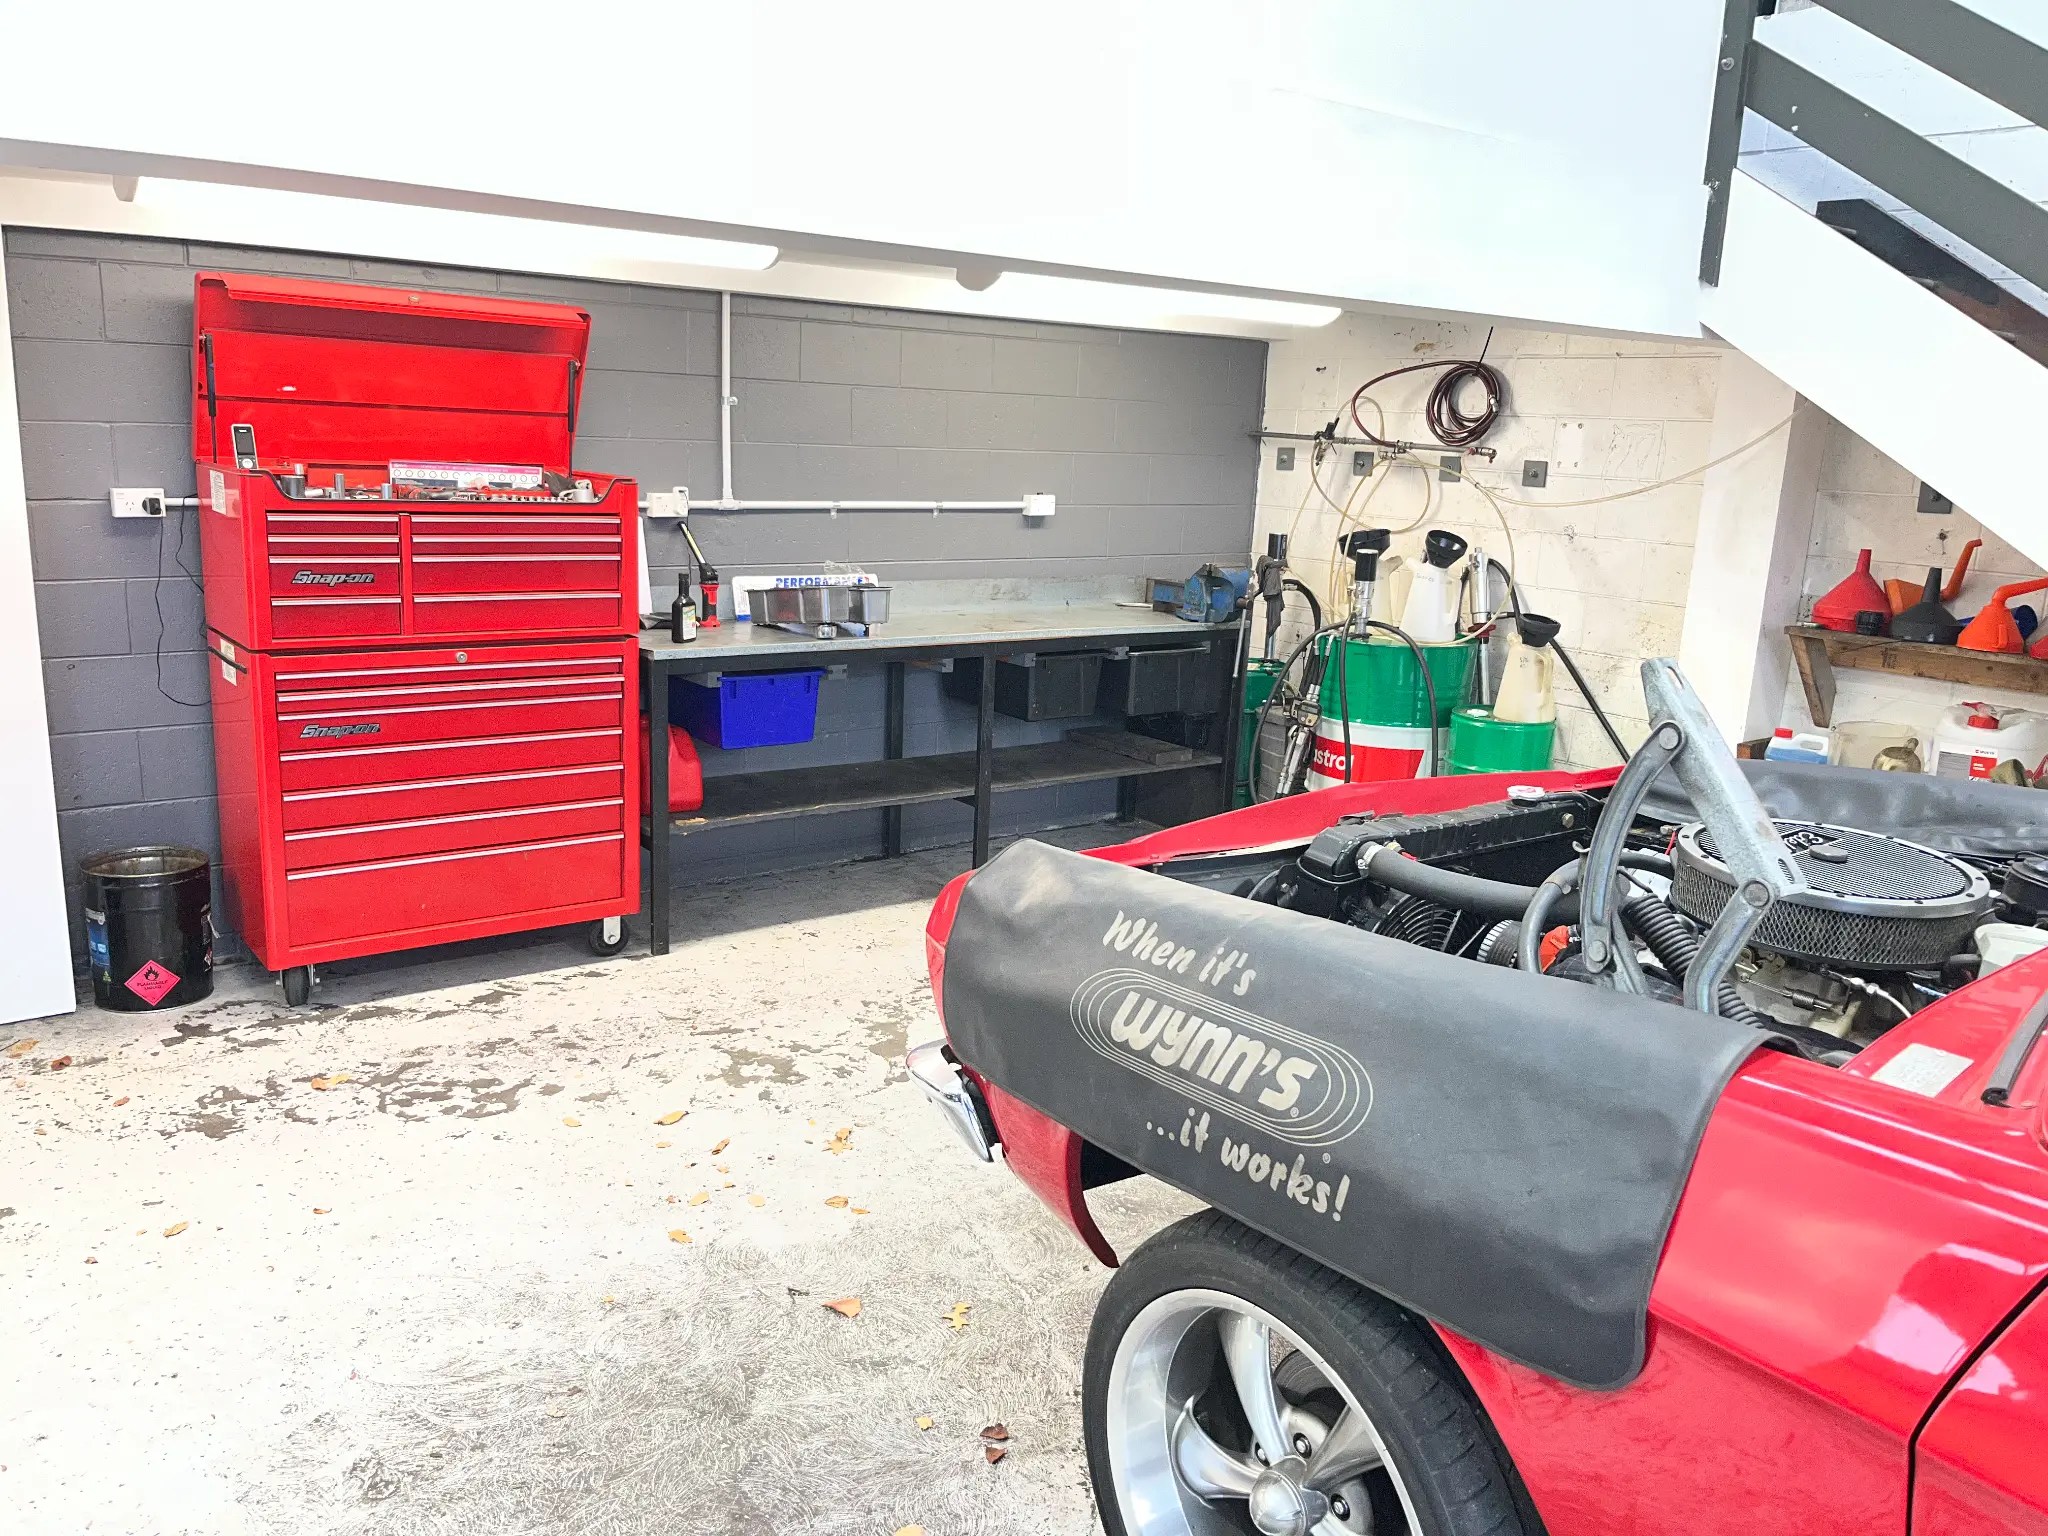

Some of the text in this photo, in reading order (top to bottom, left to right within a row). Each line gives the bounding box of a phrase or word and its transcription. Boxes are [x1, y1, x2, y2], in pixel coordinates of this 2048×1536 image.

[292, 570, 375, 587] Snap-on
[300, 723, 381, 739] Snap-on
[1102, 910, 1256, 996] When it's
[1220, 1136, 1350, 1222] works!
